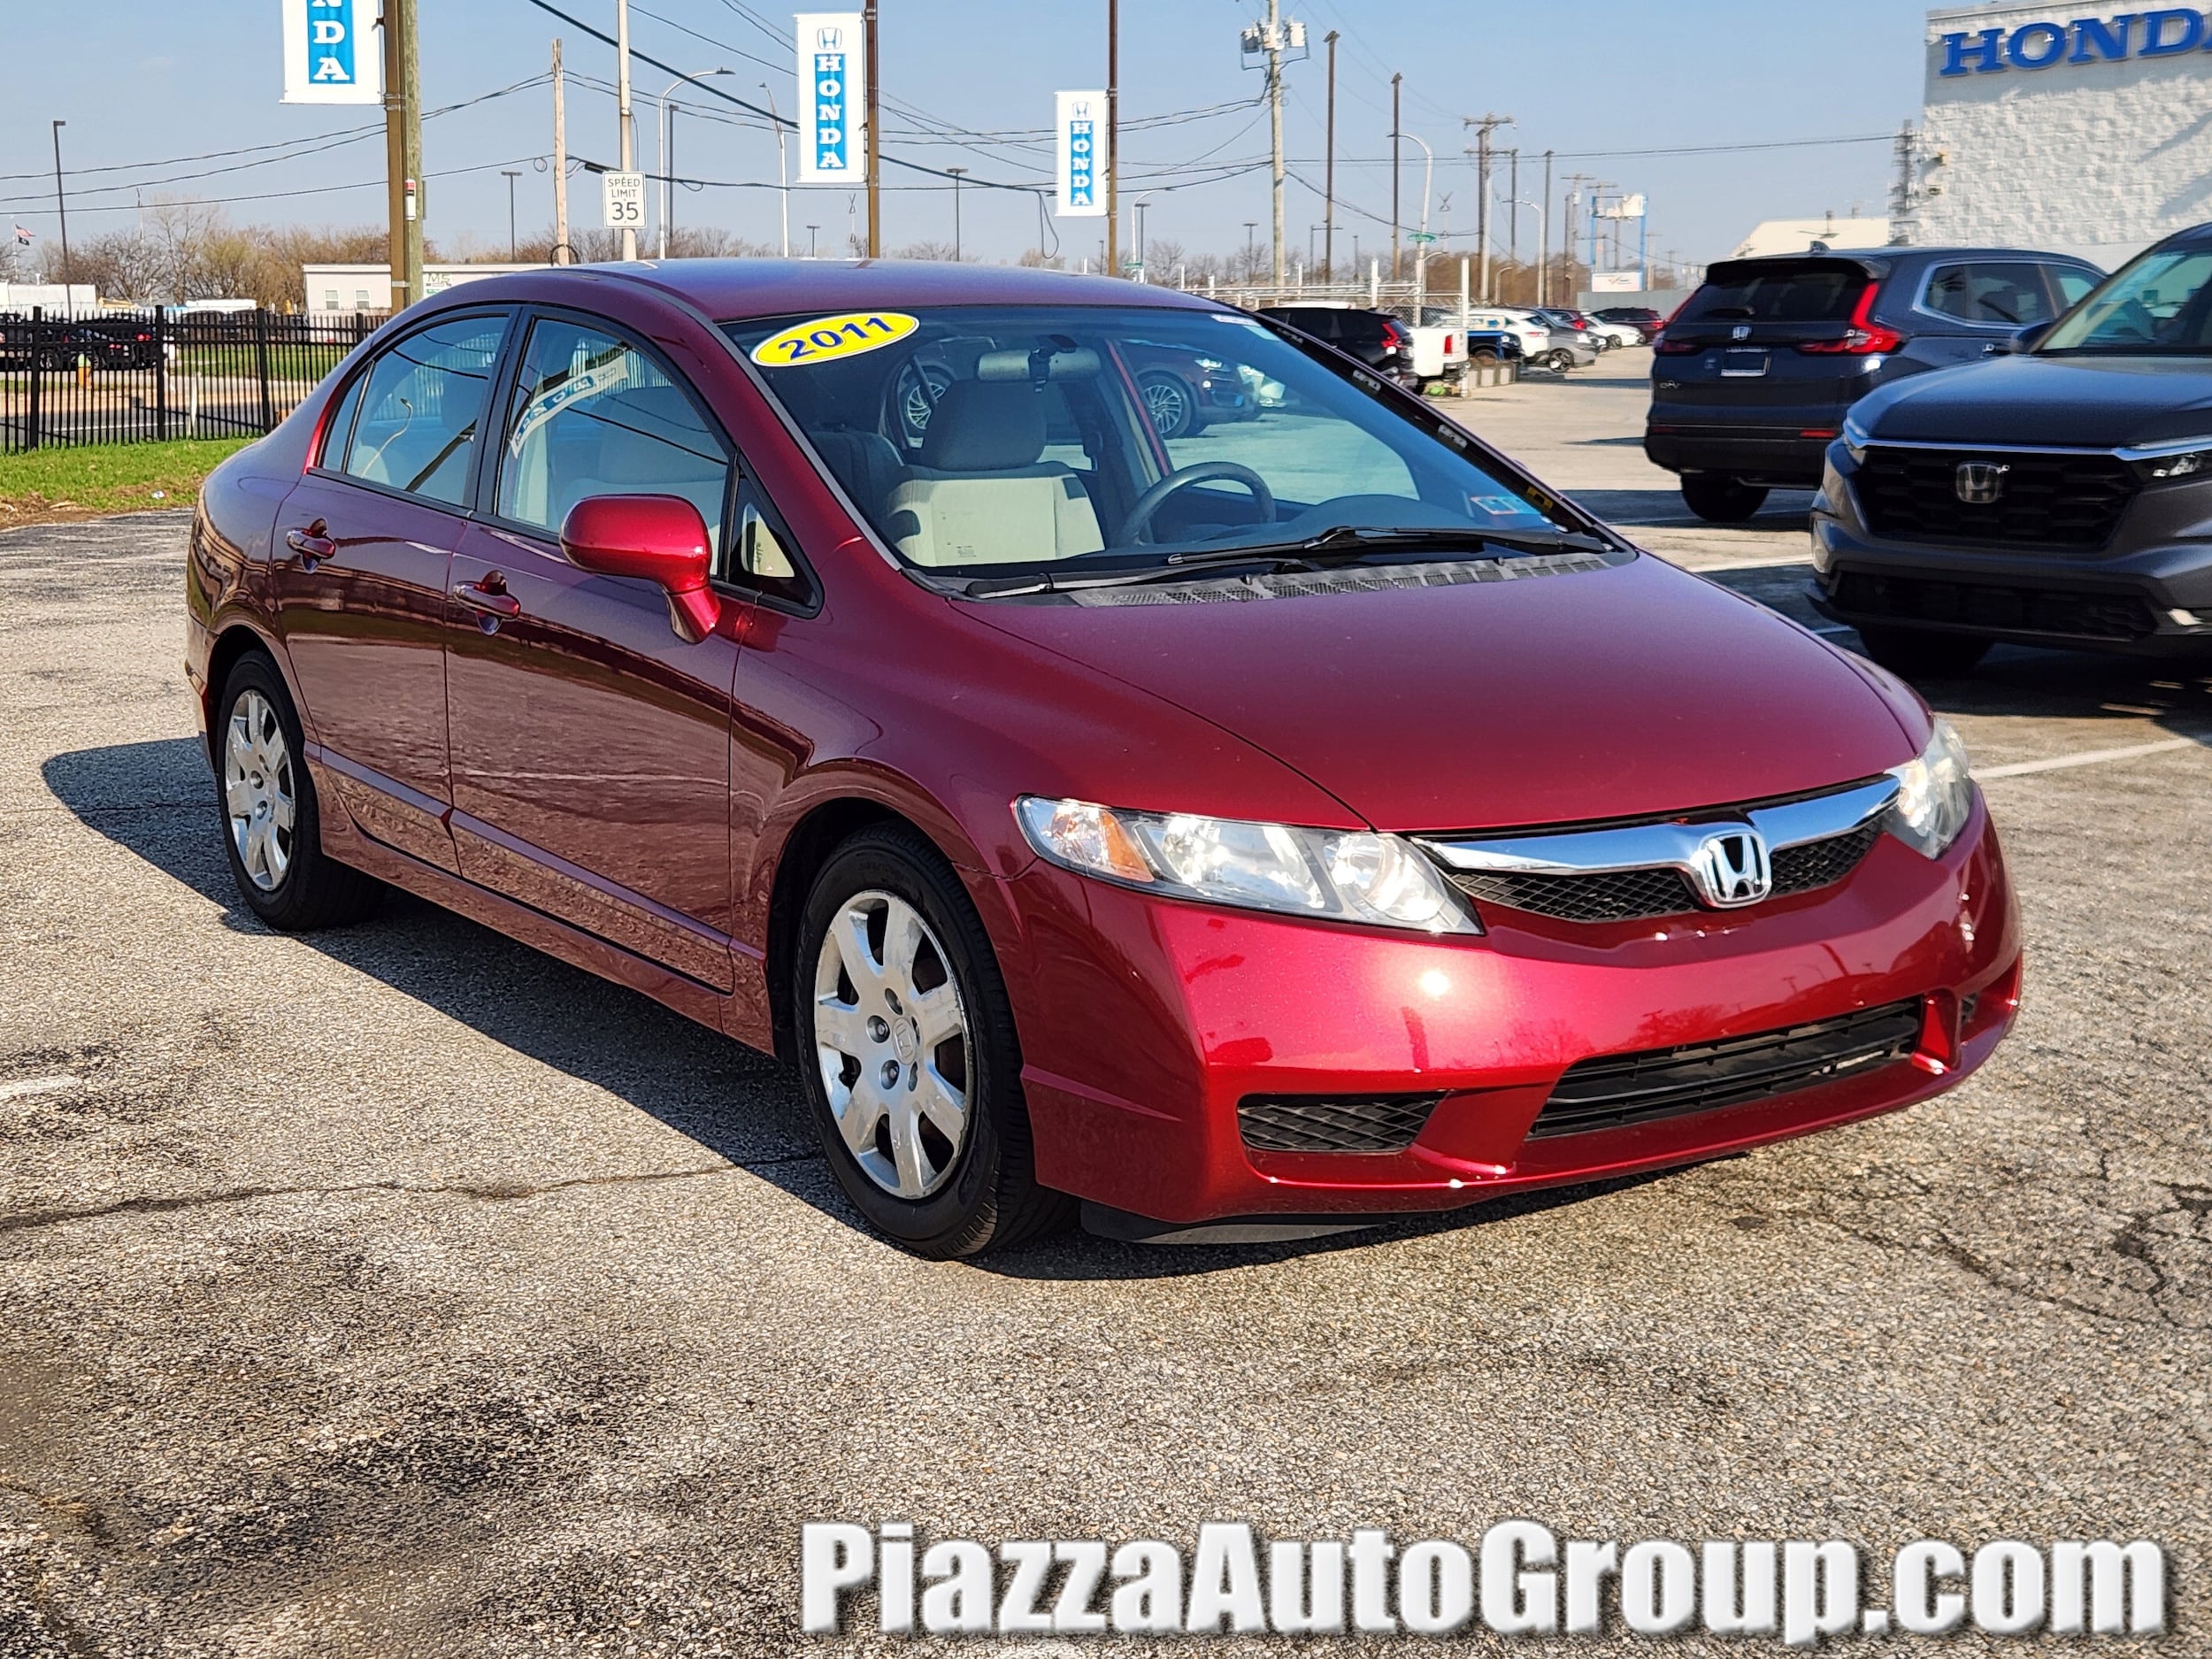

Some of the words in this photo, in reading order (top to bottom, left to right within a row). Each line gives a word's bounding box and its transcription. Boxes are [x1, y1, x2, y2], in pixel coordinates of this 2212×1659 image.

[1939, 8, 2212, 76] HOND
[818, 56, 844, 168] HONDA
[608, 178, 641, 187] SPEED
[1071, 122, 1092, 205] HONDA
[611, 188, 637, 197] LIMIT
[611, 202, 639, 220] 35
[779, 318, 893, 360] 2011
